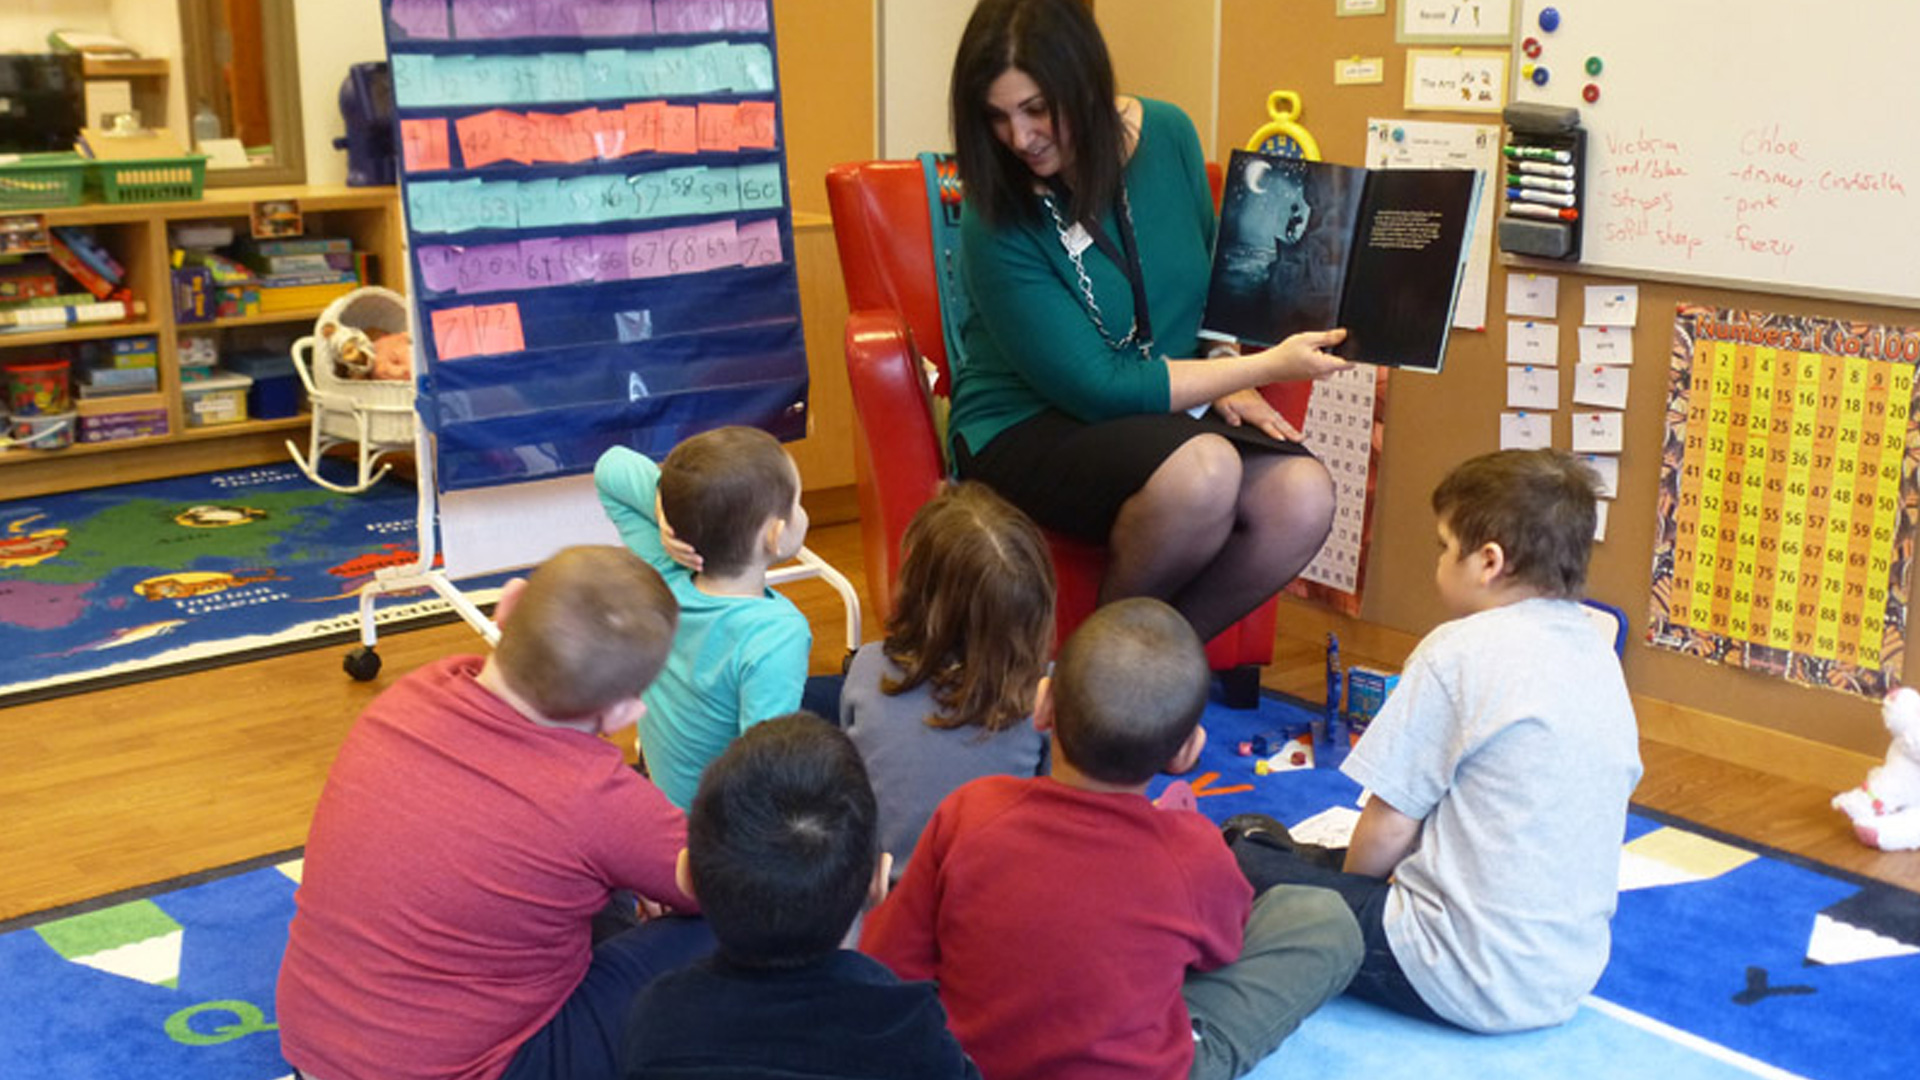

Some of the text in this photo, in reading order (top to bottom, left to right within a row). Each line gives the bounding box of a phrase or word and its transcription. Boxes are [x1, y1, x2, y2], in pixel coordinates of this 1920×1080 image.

[1741, 124, 1806, 161] Chloe
[632, 181, 661, 213] 57
[670, 175, 694, 197] 58
[700, 183, 728, 205] 59
[743, 179, 776, 201] 60
[631, 241, 657, 268] 67
[668, 235, 698, 271] 68
[706, 240, 728, 258] 69
[741, 236, 775, 262] 70
[1696, 315, 1801, 349] Numbers
[1834, 331, 1860, 354] to
[1873, 332, 1920, 362] 100
[1701, 352, 1910, 389] 1 2 3 4 5 6 7 8 9 10
[1694, 377, 1708, 390] 11
[1716, 380, 1730, 395] 12
[1756, 387, 1769, 400] 14
[1777, 390, 1791, 404] 15
[1799, 392, 1814, 406] 16
[1823, 395, 1838, 409] 17
[1846, 398, 1860, 412] 18
[1869, 401, 1884, 415] 19
[1890, 404, 1906, 419] 20
[1691, 406, 1902, 450] 21 22 23 24 25 26 27 28 29 30
[1687, 436, 1702, 449] 31
[1710, 438, 1724, 453] 32
[1749, 445, 1764, 458] 34
[1792, 452, 1808, 466] 36
[1815, 455, 1831, 469] 37
[1838, 459, 1853, 473] 38
[1861, 462, 1877, 477] 39
[1685, 465, 1894, 511] 41 42 43 44 45 46 47 48 49 50
[1683, 493, 1697, 506] 51
[1704, 496, 1718, 510] 52
[1724, 500, 1738, 514] 53
[1744, 504, 1757, 517] 54
[1764, 507, 1779, 522] 55
[1786, 512, 1802, 525] 56
[1854, 523, 1870, 537] 59
[1874, 527, 1891, 542] 60
[1680, 521, 1887, 571] 61 62 63 64 65 66 67 68 69 70
[176, 587, 272, 609] Indian
[1700, 553, 1713, 567] 72
[1719, 557, 1733, 571] 73
[1739, 561, 1752, 575] 74
[1758, 565, 1773, 580] 75
[1780, 570, 1795, 583] 76
[1803, 573, 1818, 587] 77
[1825, 578, 1840, 593] 78
[1848, 582, 1863, 597] 79
[1868, 587, 1884, 602] 80
[1696, 581, 1711, 595] 82
[1715, 585, 1730, 600] 83
[1734, 590, 1749, 603] 84
[1754, 595, 1769, 609] 85
[1775, 599, 1793, 613] 86
[1799, 603, 1815, 616] 87
[1843, 612, 1860, 626] 89
[1865, 617, 1881, 632] 90
[1673, 605, 1687, 619] 91
[1693, 609, 1708, 622] 92
[1732, 618, 1746, 632] 94
[1751, 623, 1766, 637] 95
[1773, 628, 1789, 641] 96
[1796, 631, 1812, 646] 97
[1859, 647, 1880, 662] 100
[164, 1000, 279, 1046] Q
